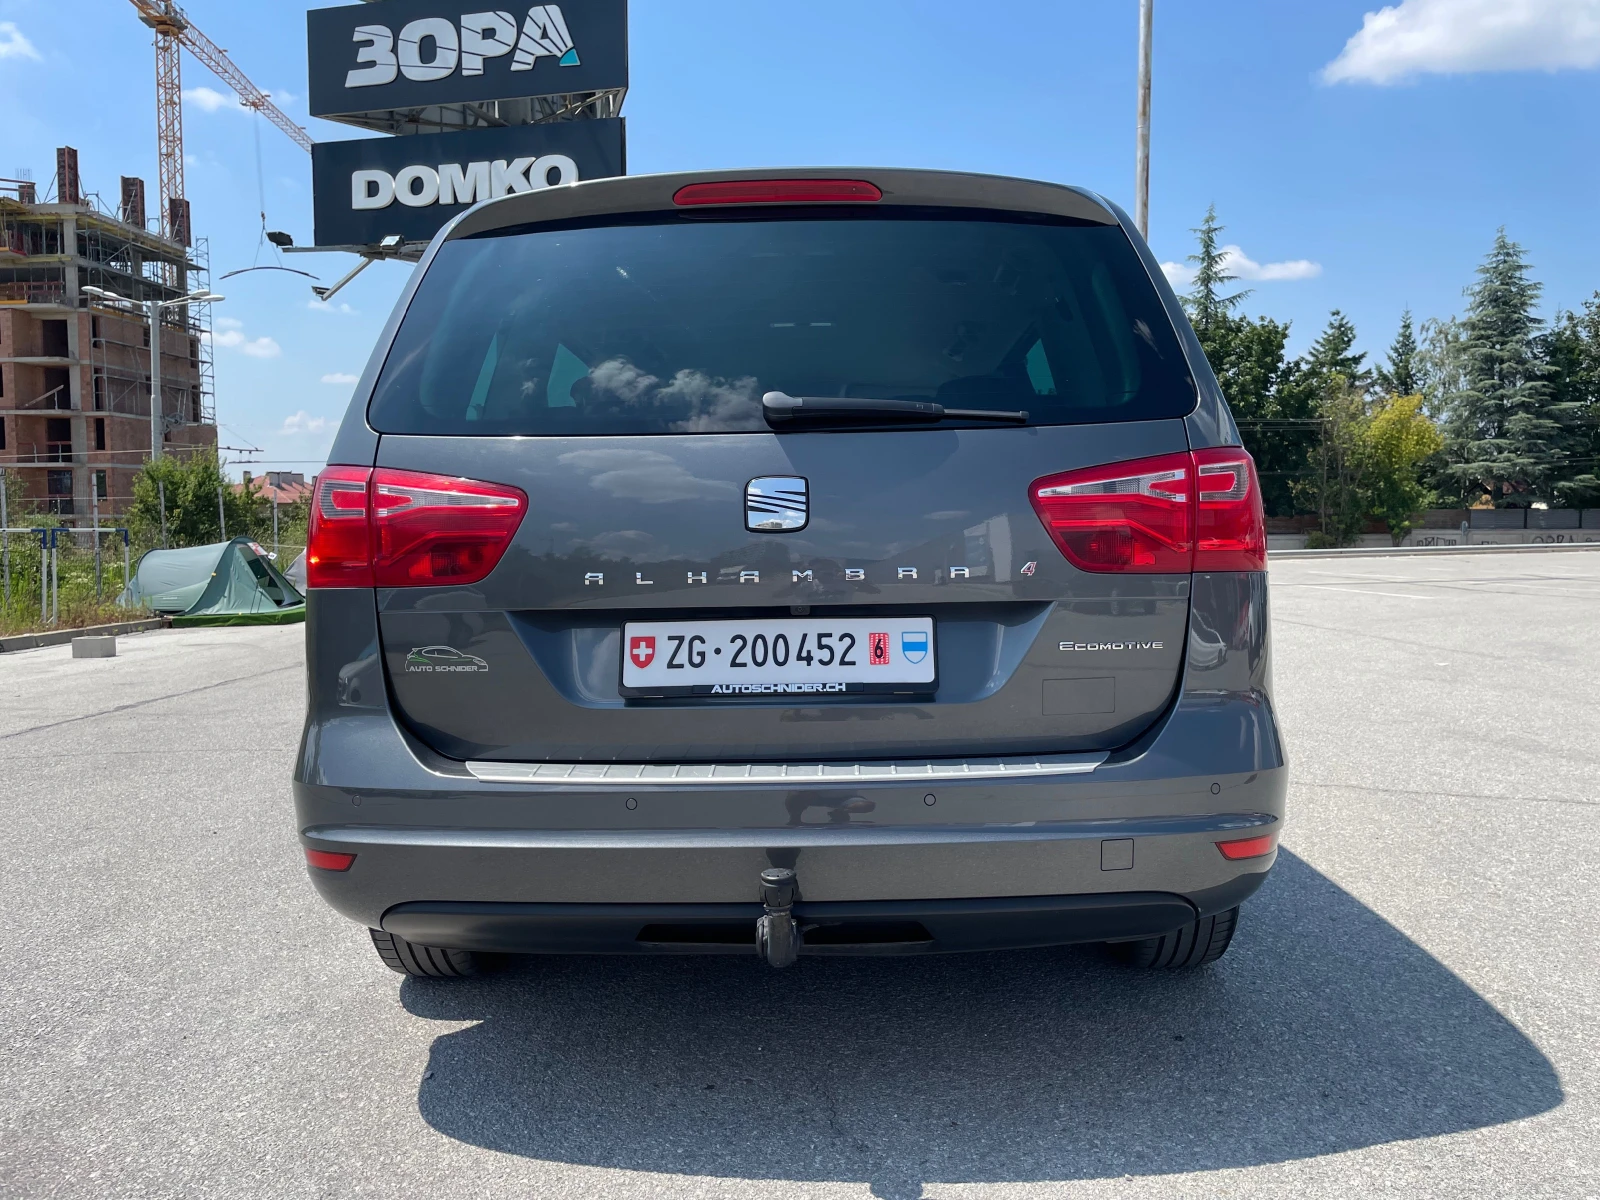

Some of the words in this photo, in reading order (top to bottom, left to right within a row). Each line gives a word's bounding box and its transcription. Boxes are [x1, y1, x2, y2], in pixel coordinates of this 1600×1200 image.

[352, 154, 579, 210] DOMKO
[584, 566, 970, 586] ALHAMBRA
[1021, 561, 1037, 576] 4
[710, 682, 847, 694] AUTOSCHNIDER.CH
